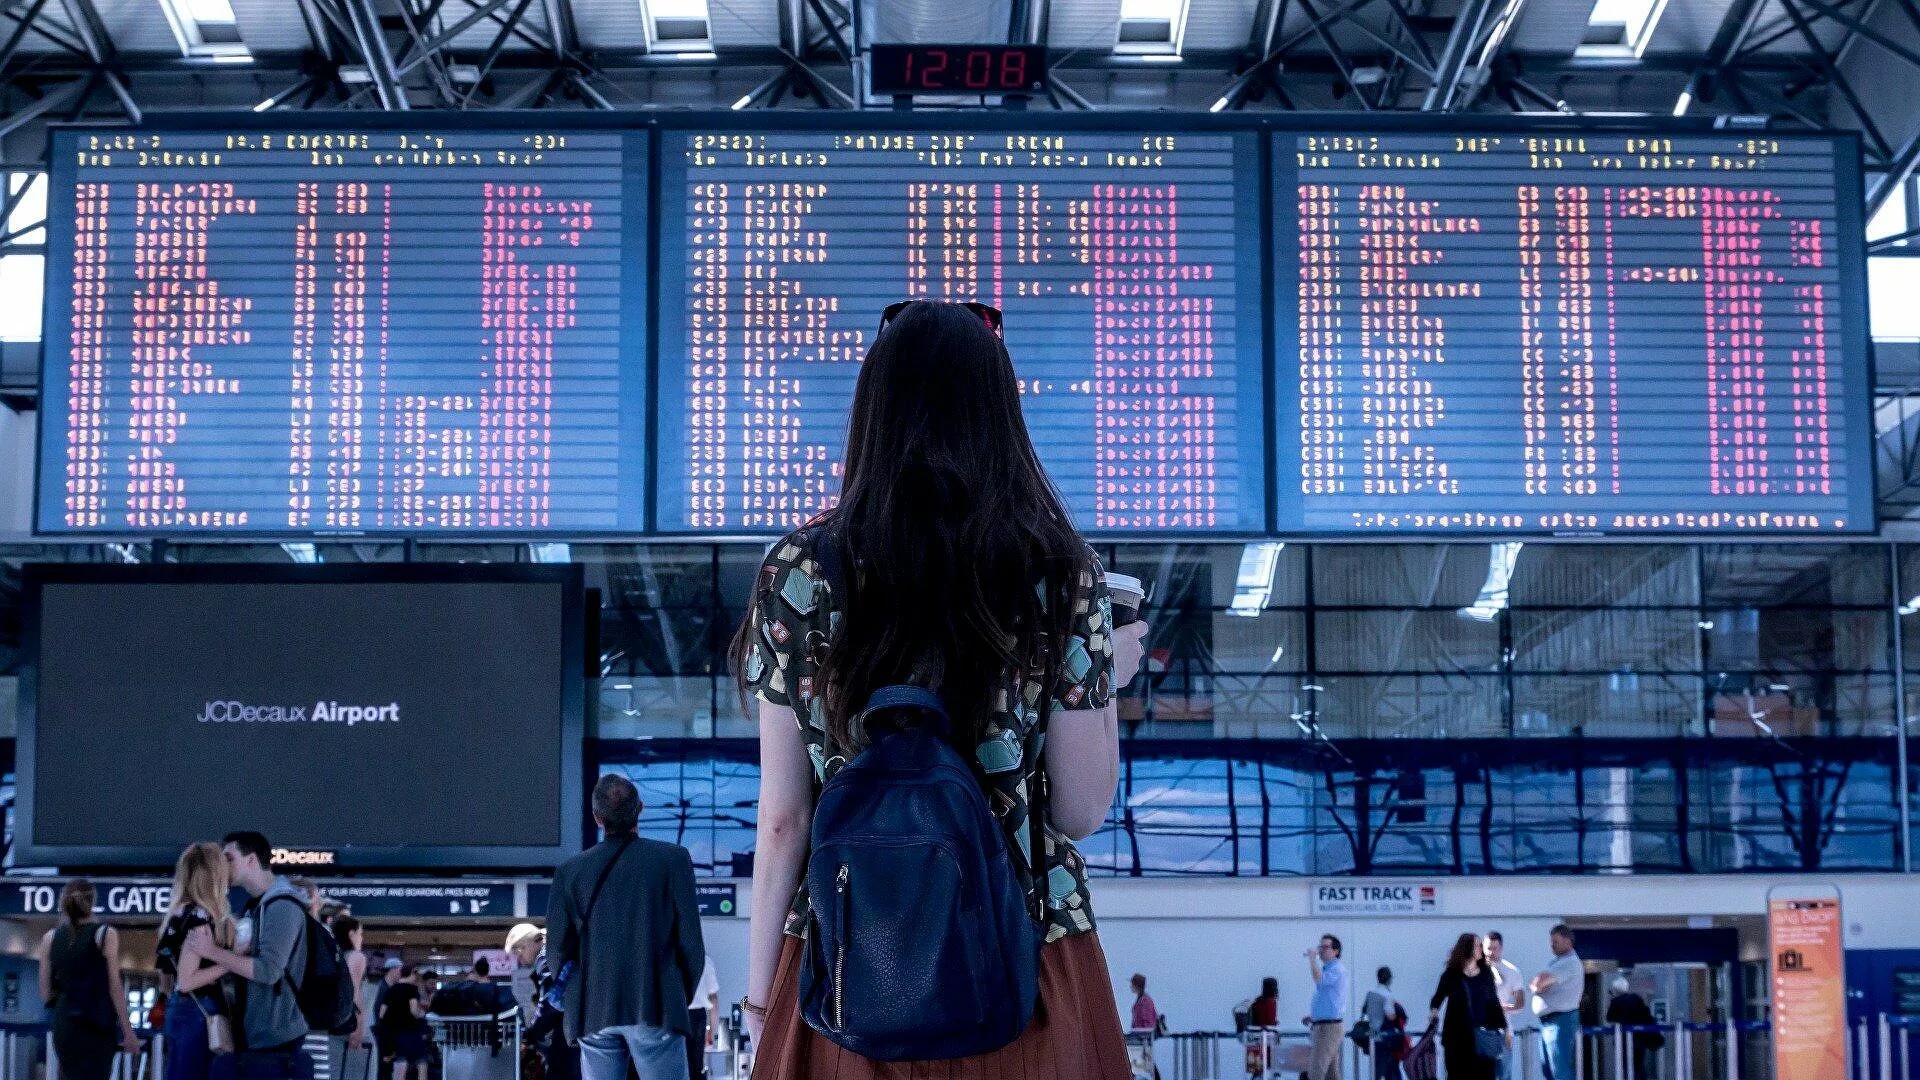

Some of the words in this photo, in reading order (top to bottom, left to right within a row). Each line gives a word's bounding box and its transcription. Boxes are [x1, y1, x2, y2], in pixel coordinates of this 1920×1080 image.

[904, 50, 1026, 87] 12:08
[196, 700, 306, 722] JCDecaux
[311, 700, 399, 726] Airport
[19, 886, 55, 912] TO
[1319, 886, 1356, 901] FAST
[1360, 886, 1412, 901] TRACK
